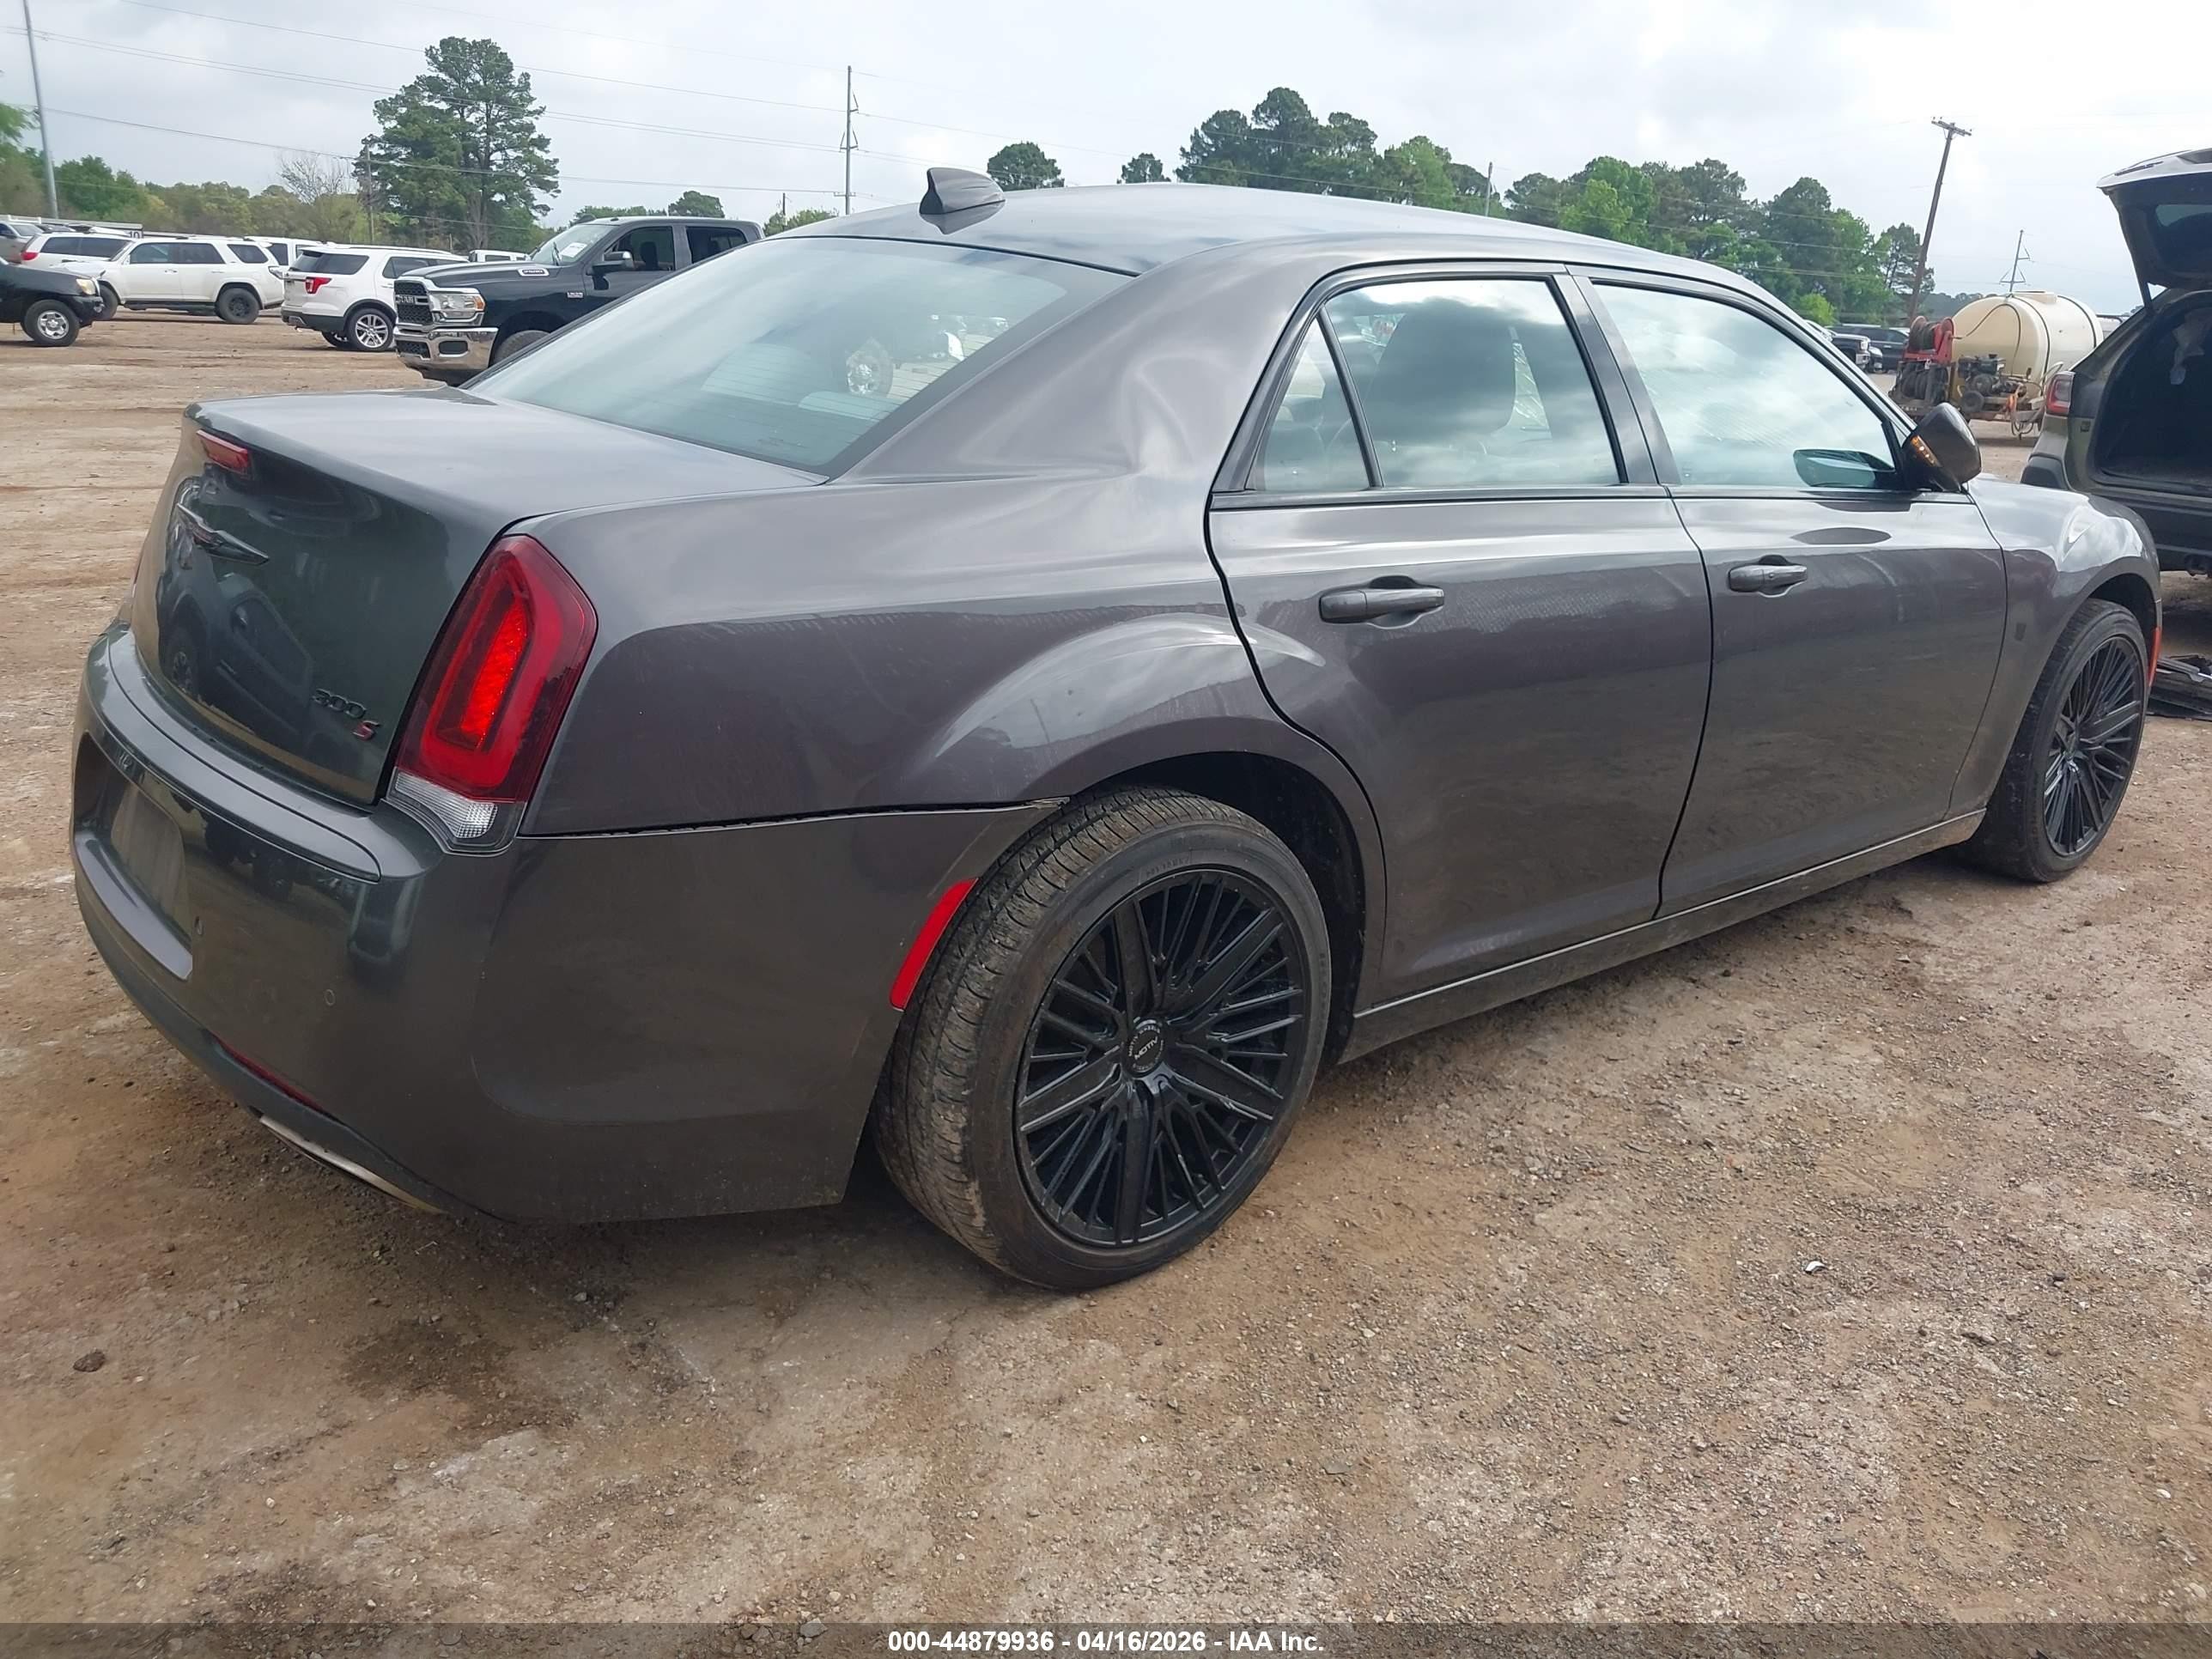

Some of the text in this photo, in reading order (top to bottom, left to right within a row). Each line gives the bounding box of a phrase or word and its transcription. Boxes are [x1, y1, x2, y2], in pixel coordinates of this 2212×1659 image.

[312, 688, 367, 719] 300
[350, 720, 381, 740] S
[1134, 1036, 1158, 1060] MOTIV
